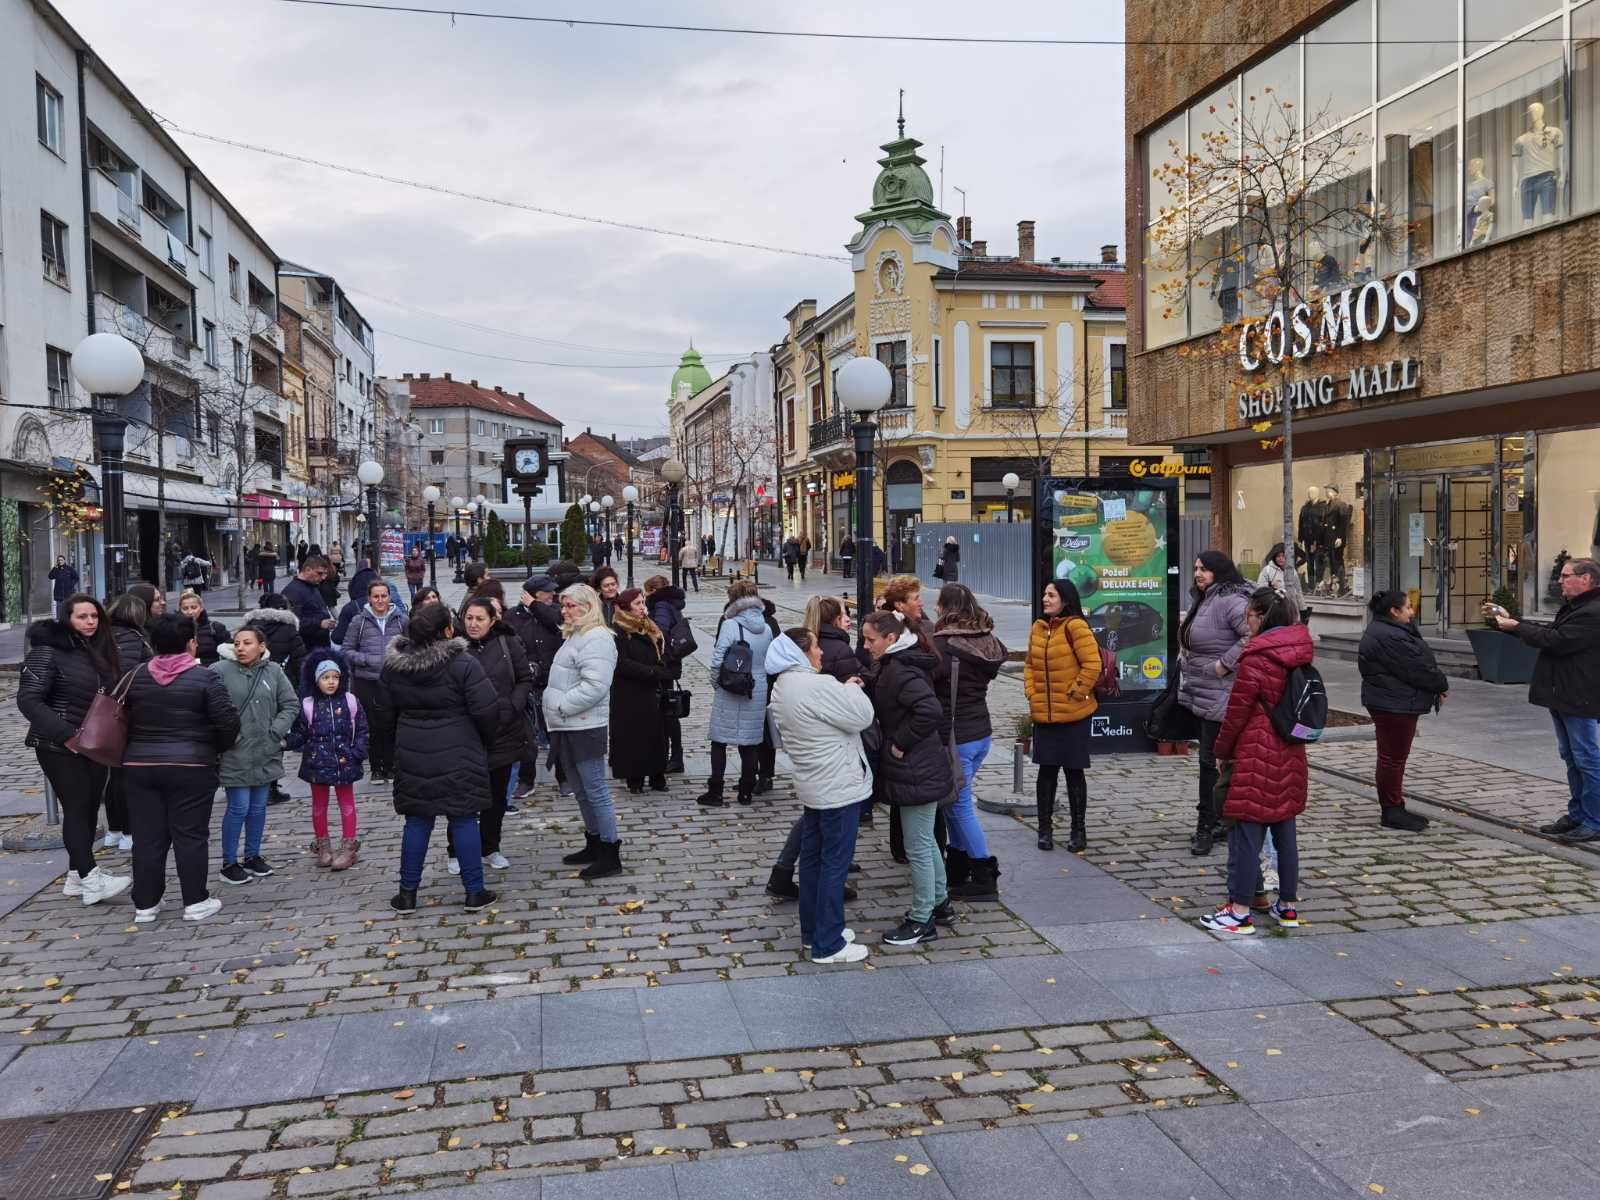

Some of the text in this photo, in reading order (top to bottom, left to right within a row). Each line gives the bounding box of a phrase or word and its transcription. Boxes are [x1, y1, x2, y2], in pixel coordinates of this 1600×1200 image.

[1239, 270, 1421, 371] COSMOS
[1347, 357, 1418, 400] MALL
[1102, 579, 1137, 589] DELUXE
[1101, 725, 1133, 736] Media
